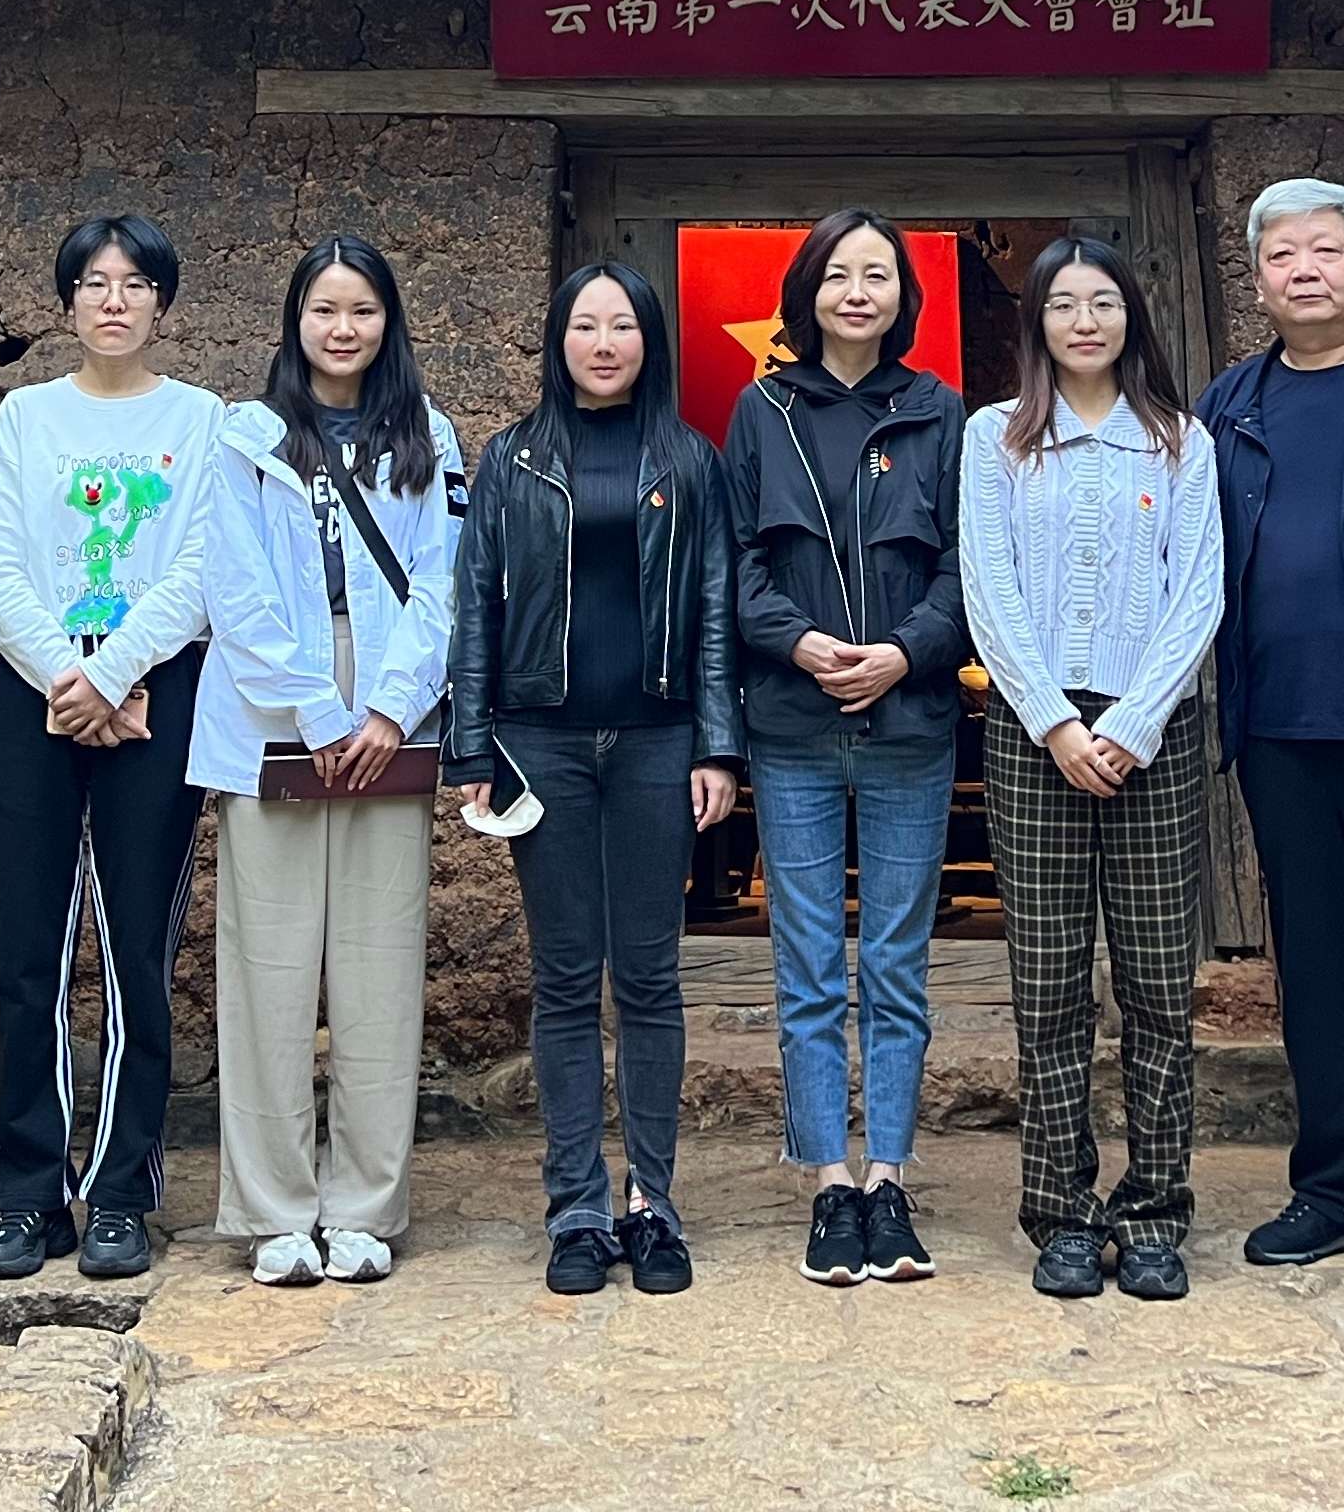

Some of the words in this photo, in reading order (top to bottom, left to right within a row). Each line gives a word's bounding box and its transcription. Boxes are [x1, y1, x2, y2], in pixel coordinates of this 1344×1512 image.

[95, 451, 153, 473] going
[56, 536, 135, 566] galaxy
[127, 578, 150, 599] th
